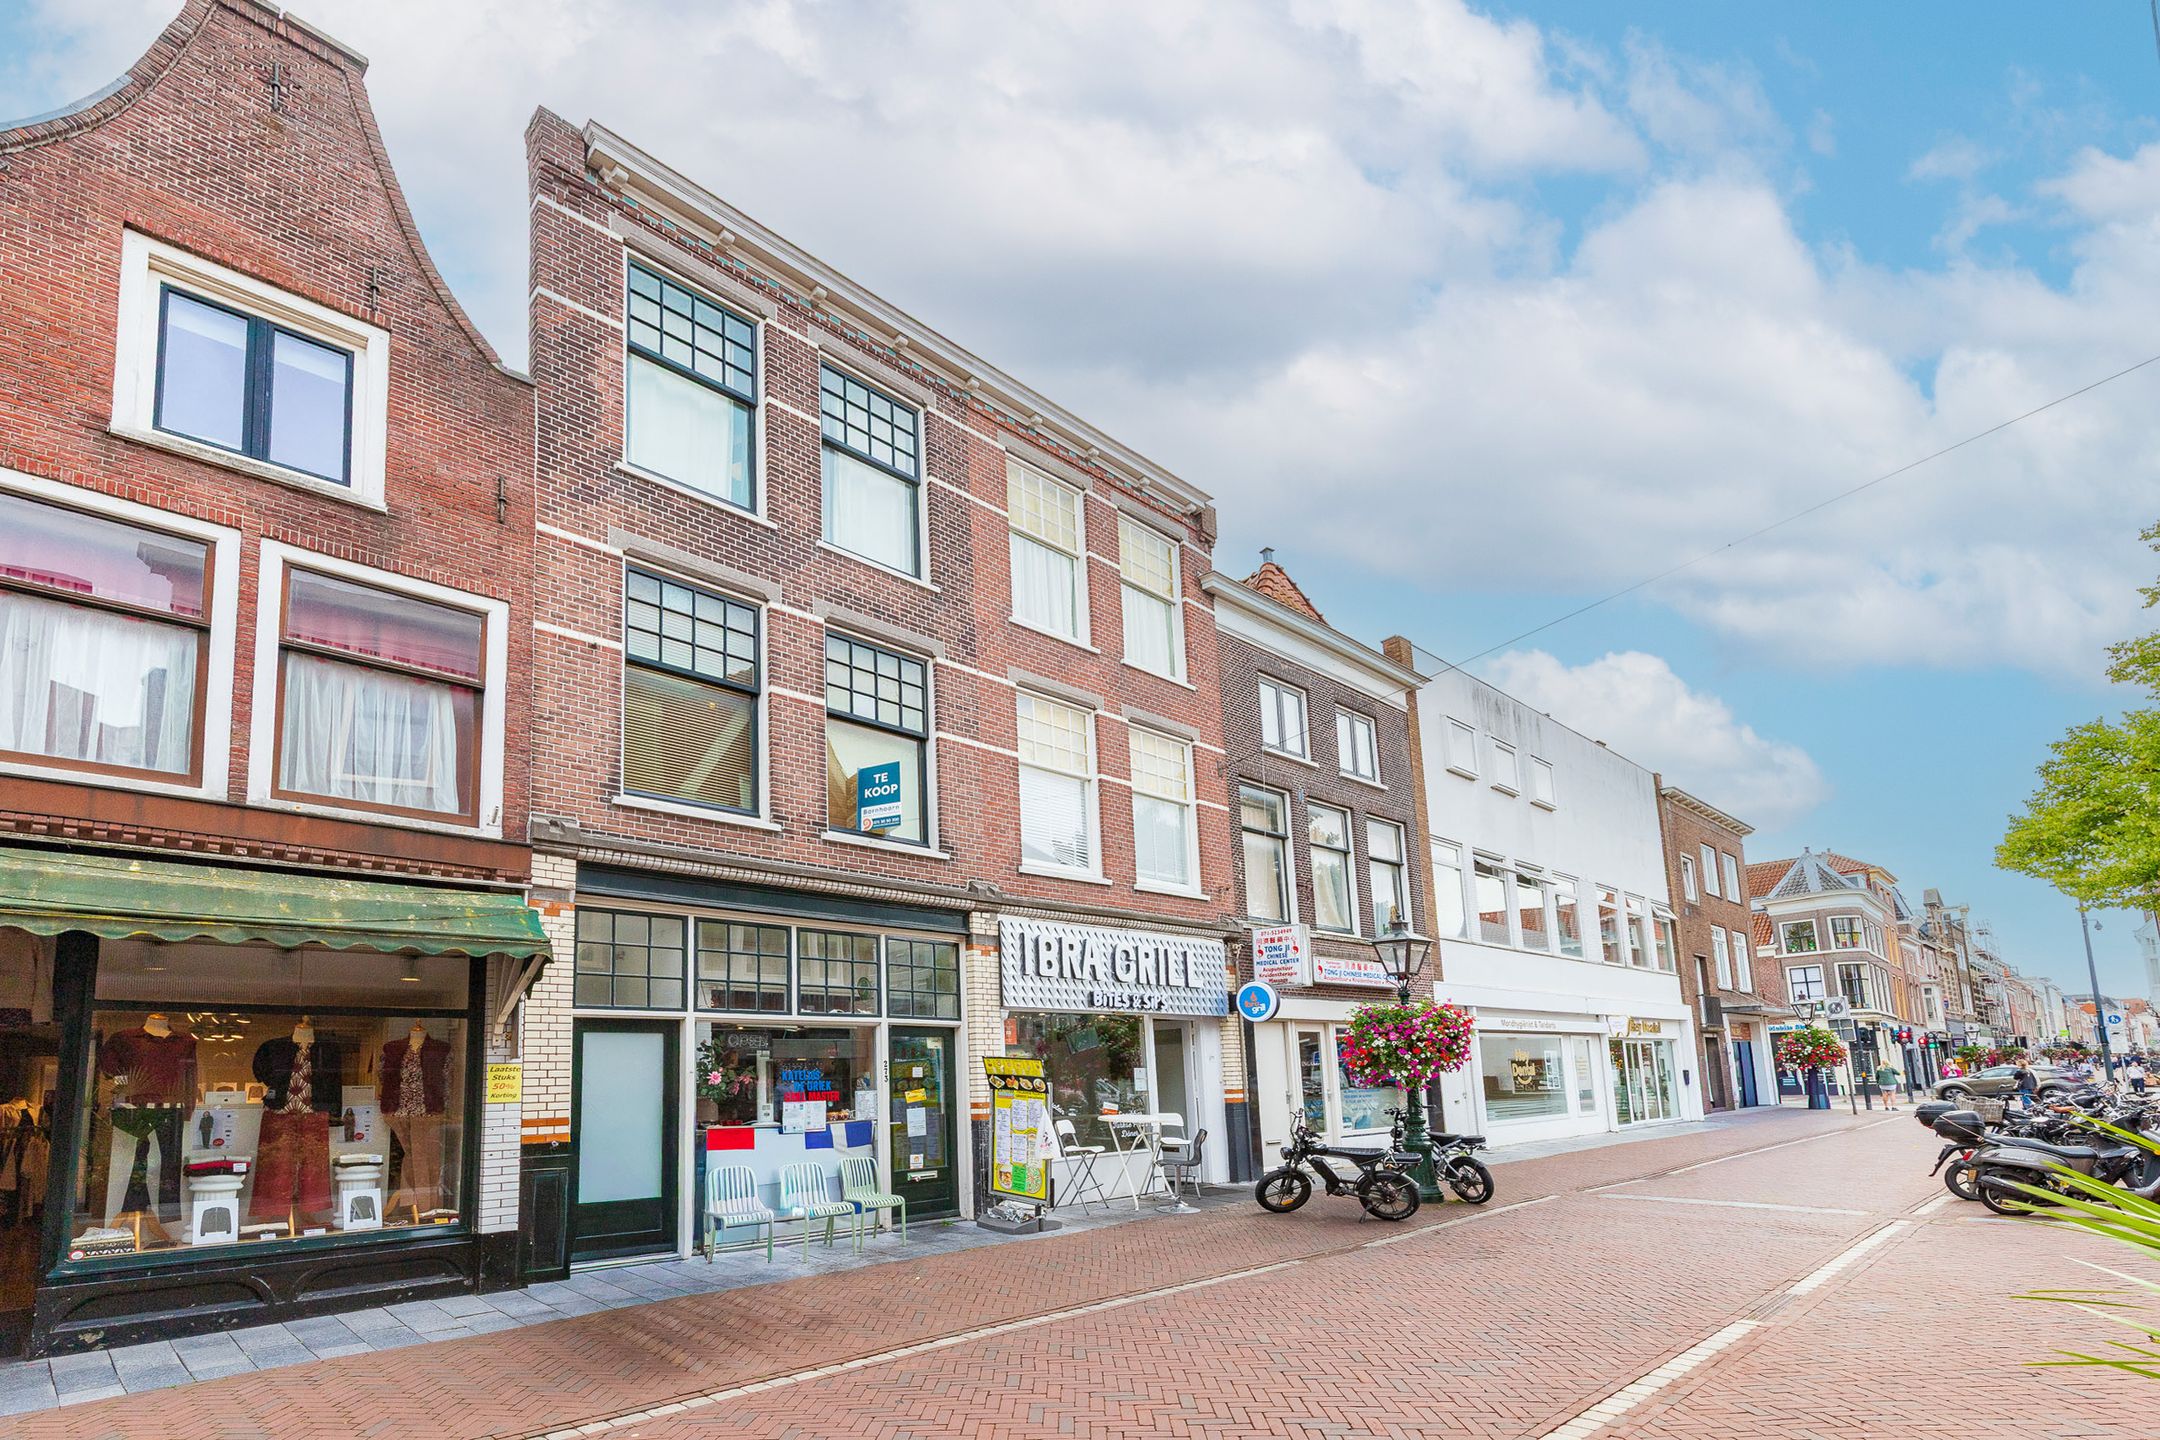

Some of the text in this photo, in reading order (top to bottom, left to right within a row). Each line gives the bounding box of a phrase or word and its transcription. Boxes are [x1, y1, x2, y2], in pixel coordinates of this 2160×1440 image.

[873, 772, 888, 784] TE
[864, 783, 898, 798] KOOP
[1264, 945, 1283, 953] TONG
[1020, 932, 1204, 988] IBRA GRILL
[1343, 970, 1362, 978] CHINESE
[1133, 993, 1143, 1009] &
[1512, 1063, 1535, 1076] Dental
[492, 1082, 515, 1090] 50%
